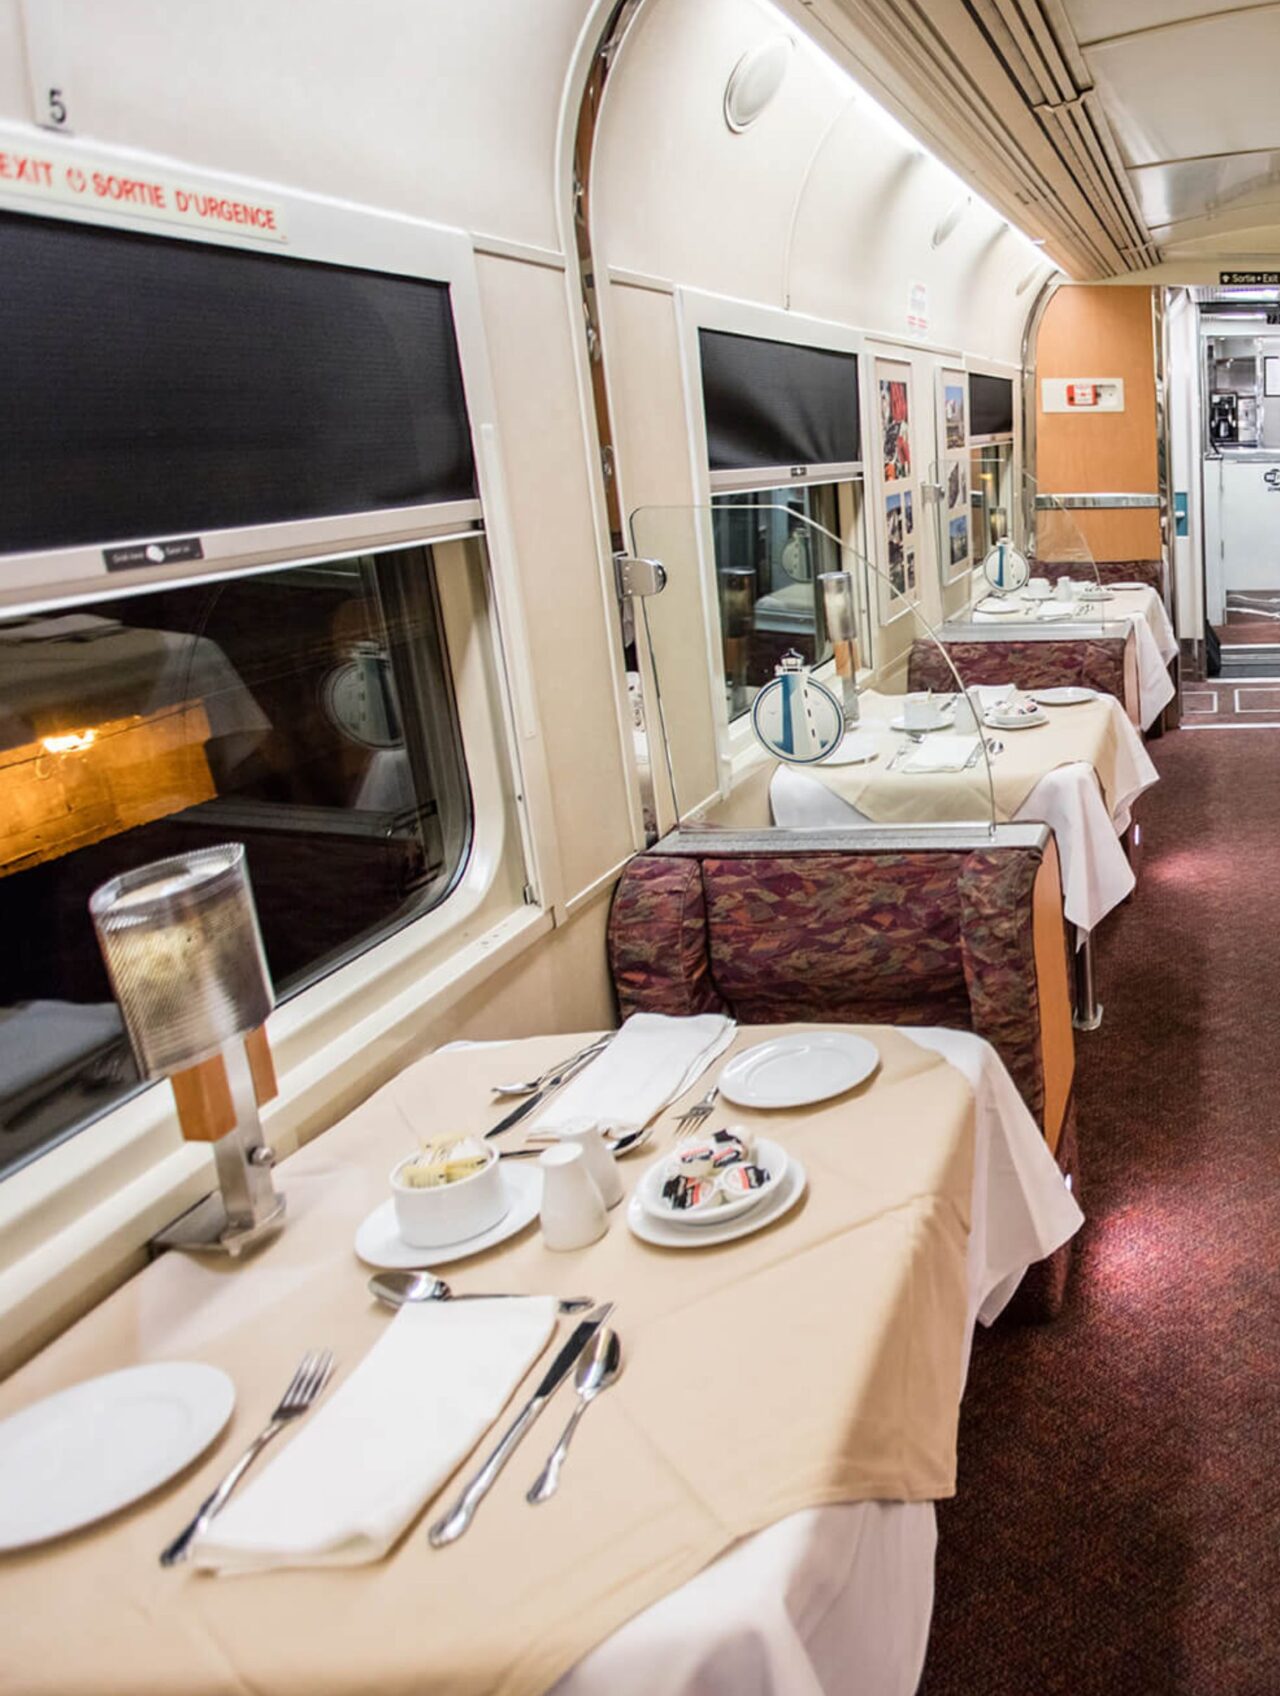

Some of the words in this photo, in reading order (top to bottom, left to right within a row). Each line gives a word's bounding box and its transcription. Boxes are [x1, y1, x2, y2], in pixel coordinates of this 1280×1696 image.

[49, 88, 67, 124] 5
[0, 153, 52, 188] EXIT
[92, 171, 167, 209] SORTIE
[175, 189, 277, 230] D'URGENCE
[1231, 273, 1256, 283] Sortie
[1262, 273, 1279, 283] Exit
